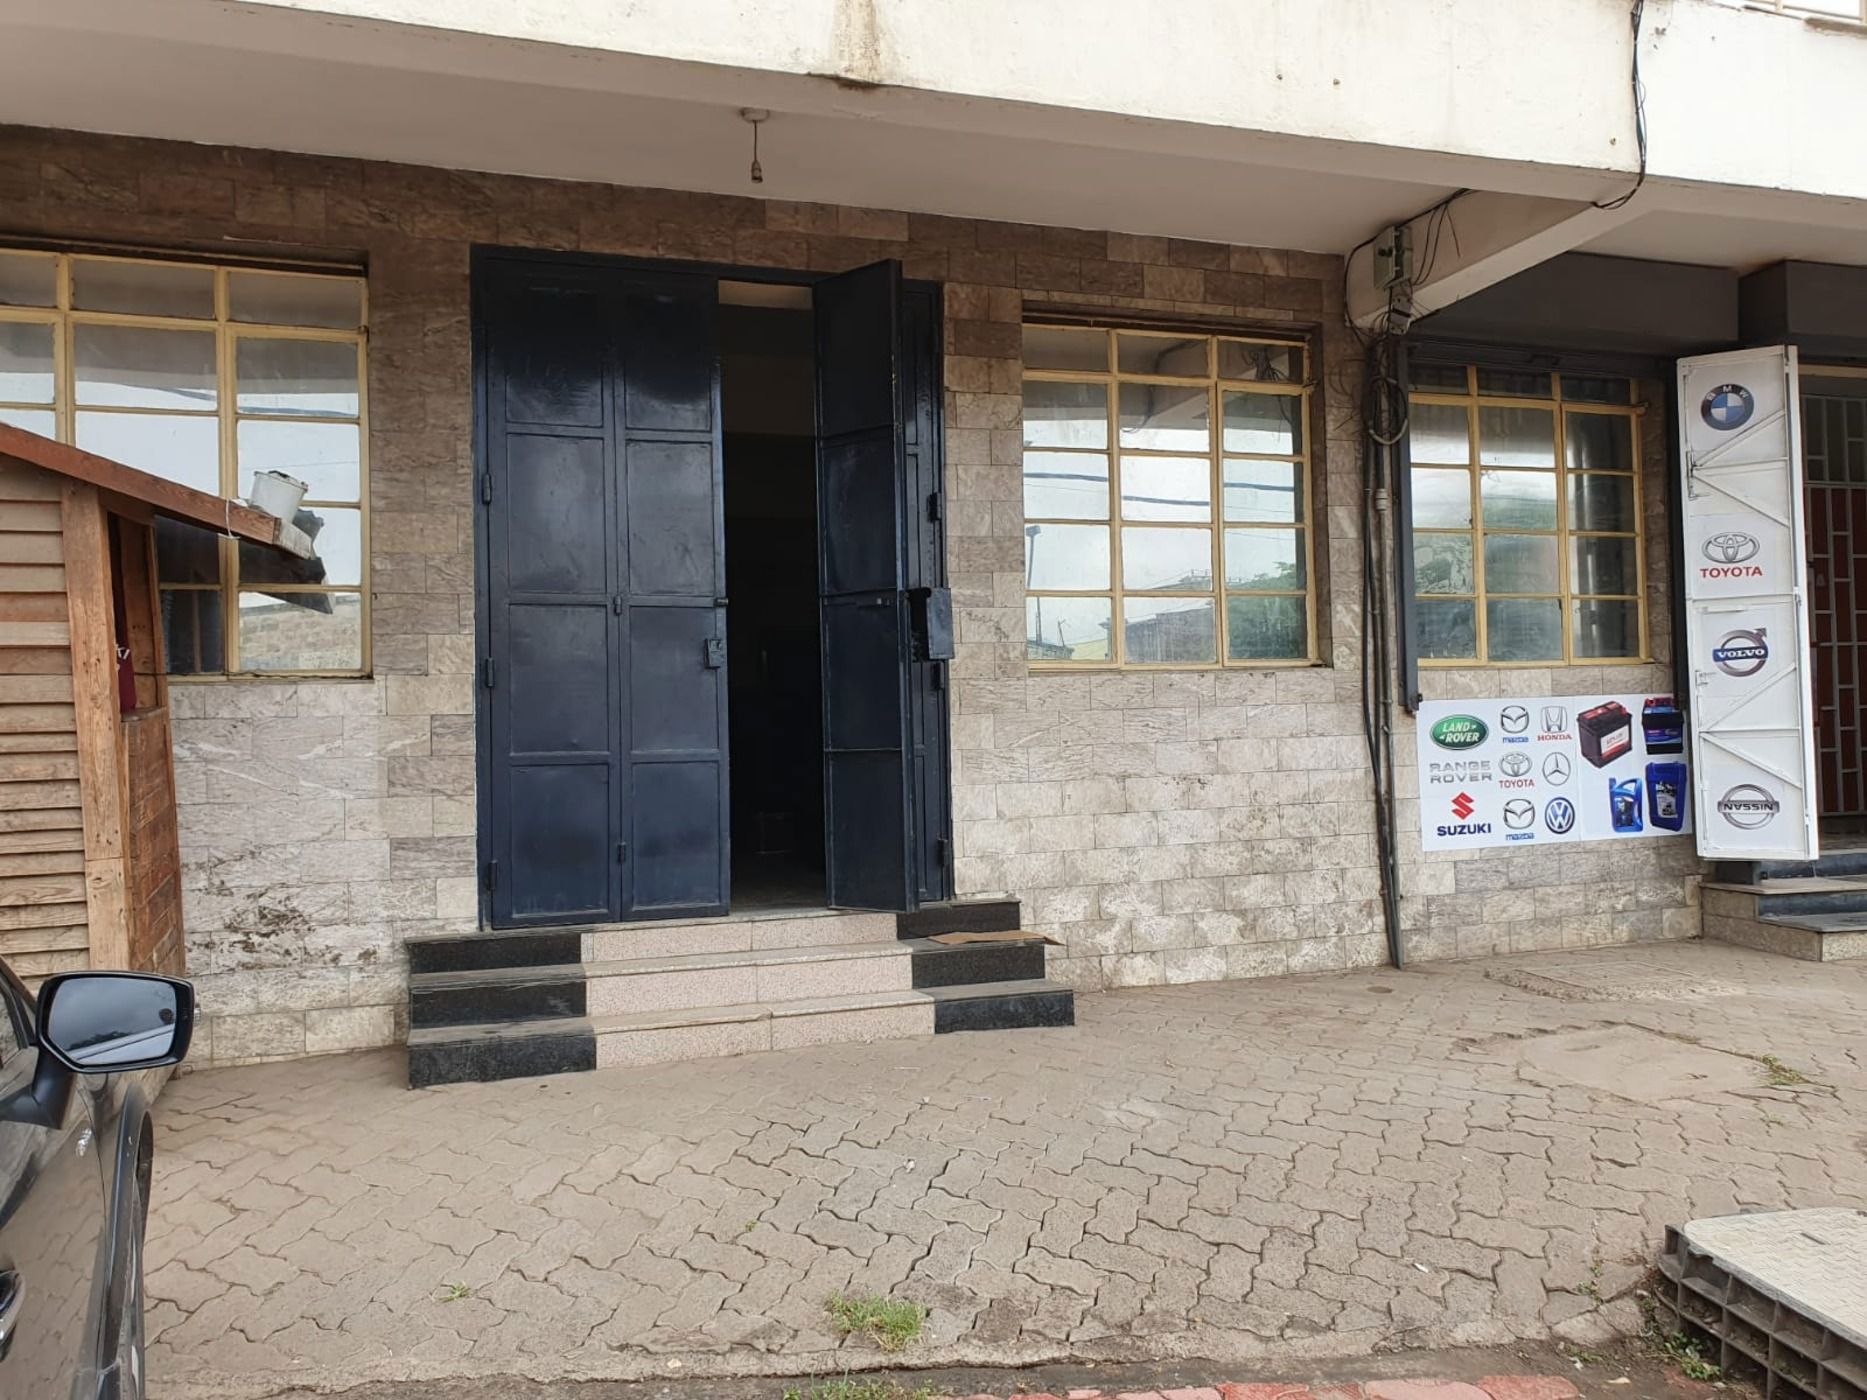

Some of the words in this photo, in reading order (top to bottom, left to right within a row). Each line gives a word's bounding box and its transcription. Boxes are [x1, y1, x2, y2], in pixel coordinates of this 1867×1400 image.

[1706, 385, 1749, 401] BMW
[1700, 566, 1763, 578] TOYOTA
[1716, 648, 1765, 658] VOLVO
[1443, 722, 1470, 732] LAND
[1445, 733, 1480, 743] ROVER
[1430, 761, 1491, 772] RANGE
[1430, 773, 1492, 784] ROVER
[1499, 780, 1535, 788] TOYOTA
[1724, 803, 1774, 812] NISSAN
[1437, 823, 1492, 836] SUZUKI
